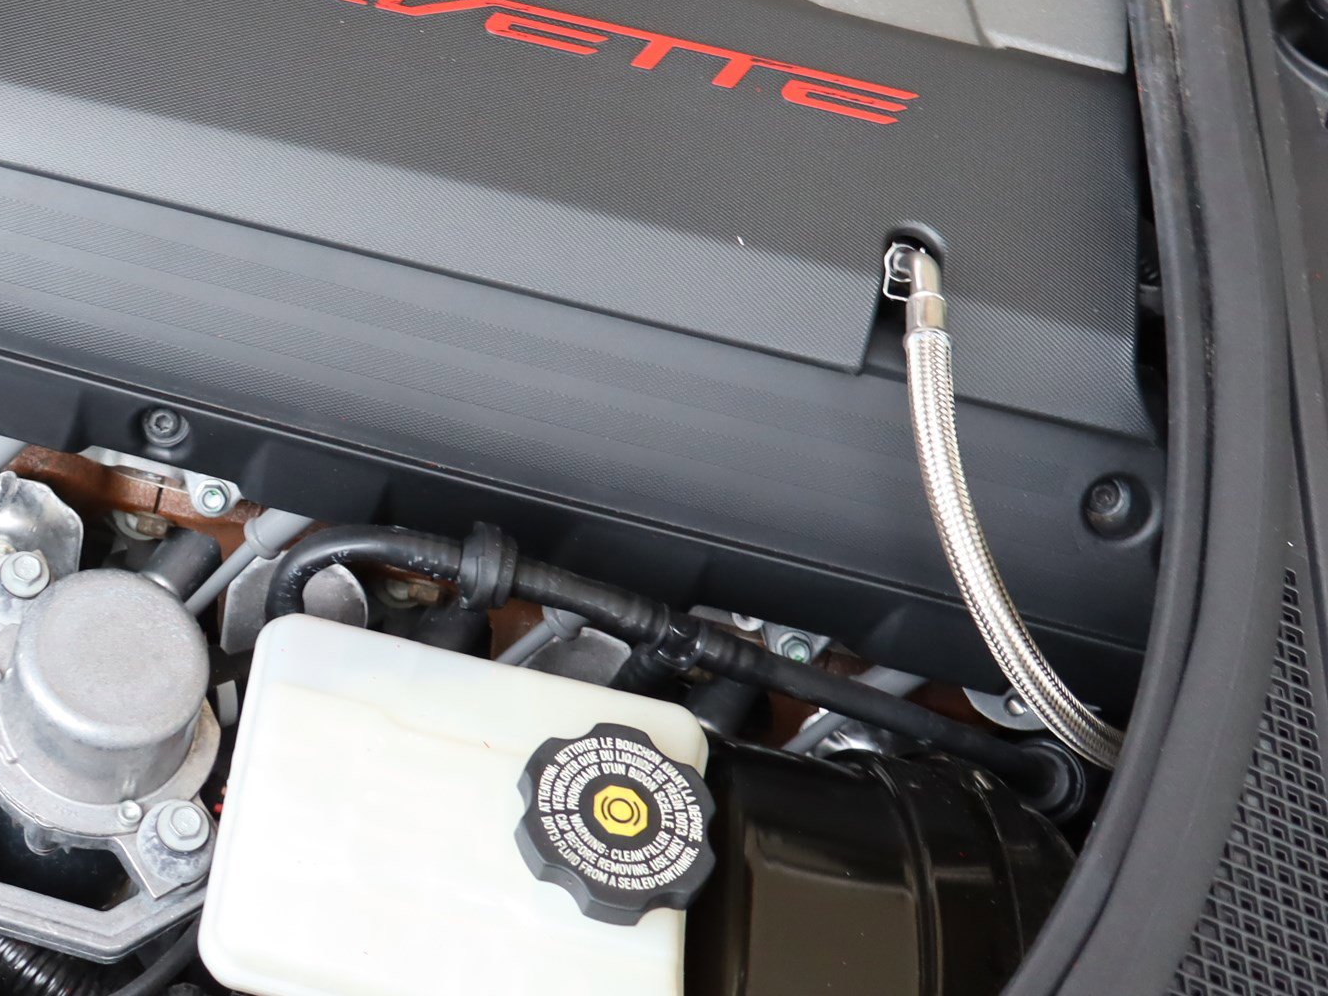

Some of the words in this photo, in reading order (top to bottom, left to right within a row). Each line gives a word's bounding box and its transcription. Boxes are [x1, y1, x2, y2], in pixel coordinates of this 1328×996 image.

[554, 737, 601, 764] NETTOYER
[600, 737, 614, 749] LE
[615, 738, 664, 764] BOUCHON
[659, 761, 690, 792] AVANT
[681, 789, 697, 804] LA
[567, 765, 601, 811] PROVENANT
[603, 763, 626, 775] D'UN
[628, 766, 660, 792] BIDON
[578, 751, 600, 767] QUE
[599, 750, 615, 762] DU
[616, 751, 655, 774] LIQUIDE
[652, 765, 668, 784] DE
[663, 782, 685, 811] FREIN
[674, 811, 688, 837] DOT3
[541, 816, 561, 841] DOT3
[554, 840, 581, 866] FLUID
[578, 861, 610, 884] FROM
[608, 878, 617, 887] A
[617, 876, 656, 890] SEALED
[654, 846, 700, 886] CONTAINER.
[554, 813, 572, 831] CAP
[563, 831, 599, 864] BEFORE
[597, 858, 653, 876] REMOVING.
[649, 854, 672, 872] USE
[665, 835, 685, 860] ONLY
[569, 813, 610, 856] WARNING:
[611, 847, 644, 862] CLEAN
[643, 831, 672, 859] FILLER
